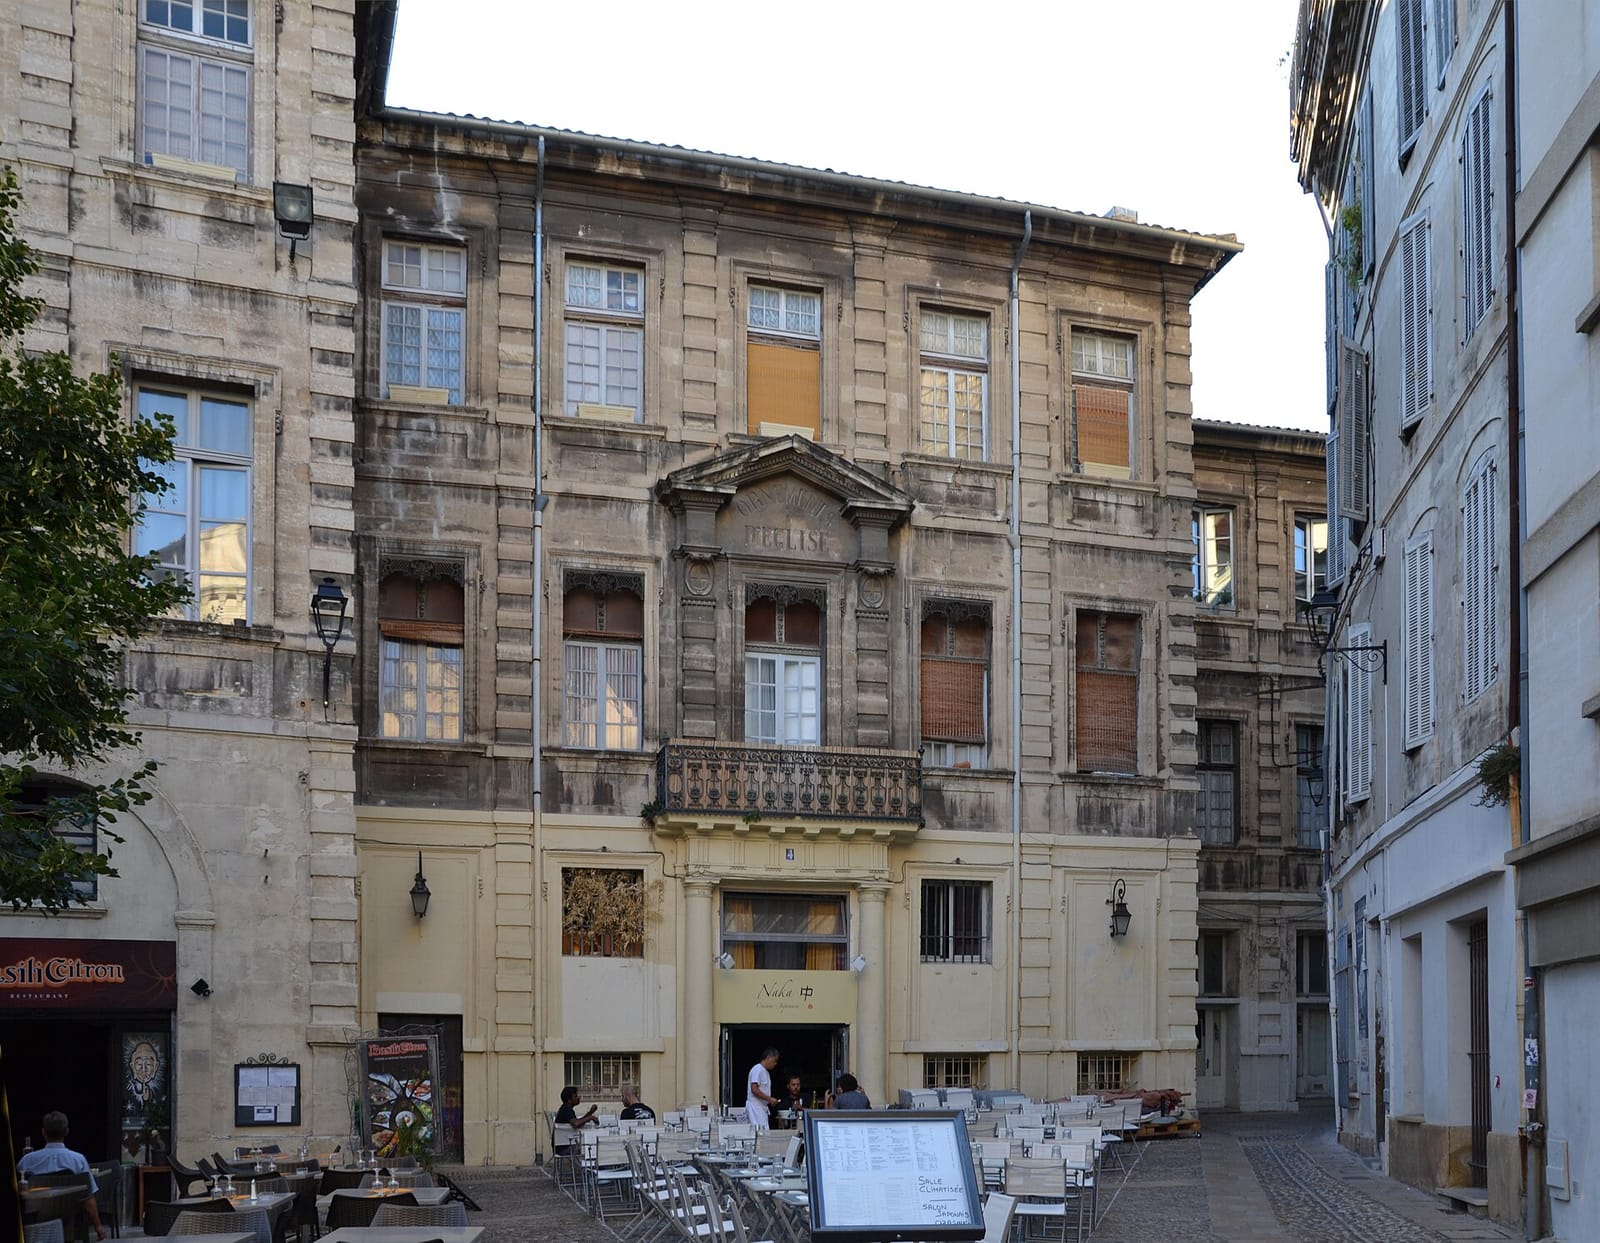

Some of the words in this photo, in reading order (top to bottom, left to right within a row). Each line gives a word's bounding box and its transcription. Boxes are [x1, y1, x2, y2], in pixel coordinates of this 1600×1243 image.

[757, 979, 793, 999] Naka
[800, 985, 813, 1001] 中
[918, 1175, 943, 1186] SALLE
[922, 1203, 947, 1211] SALON
